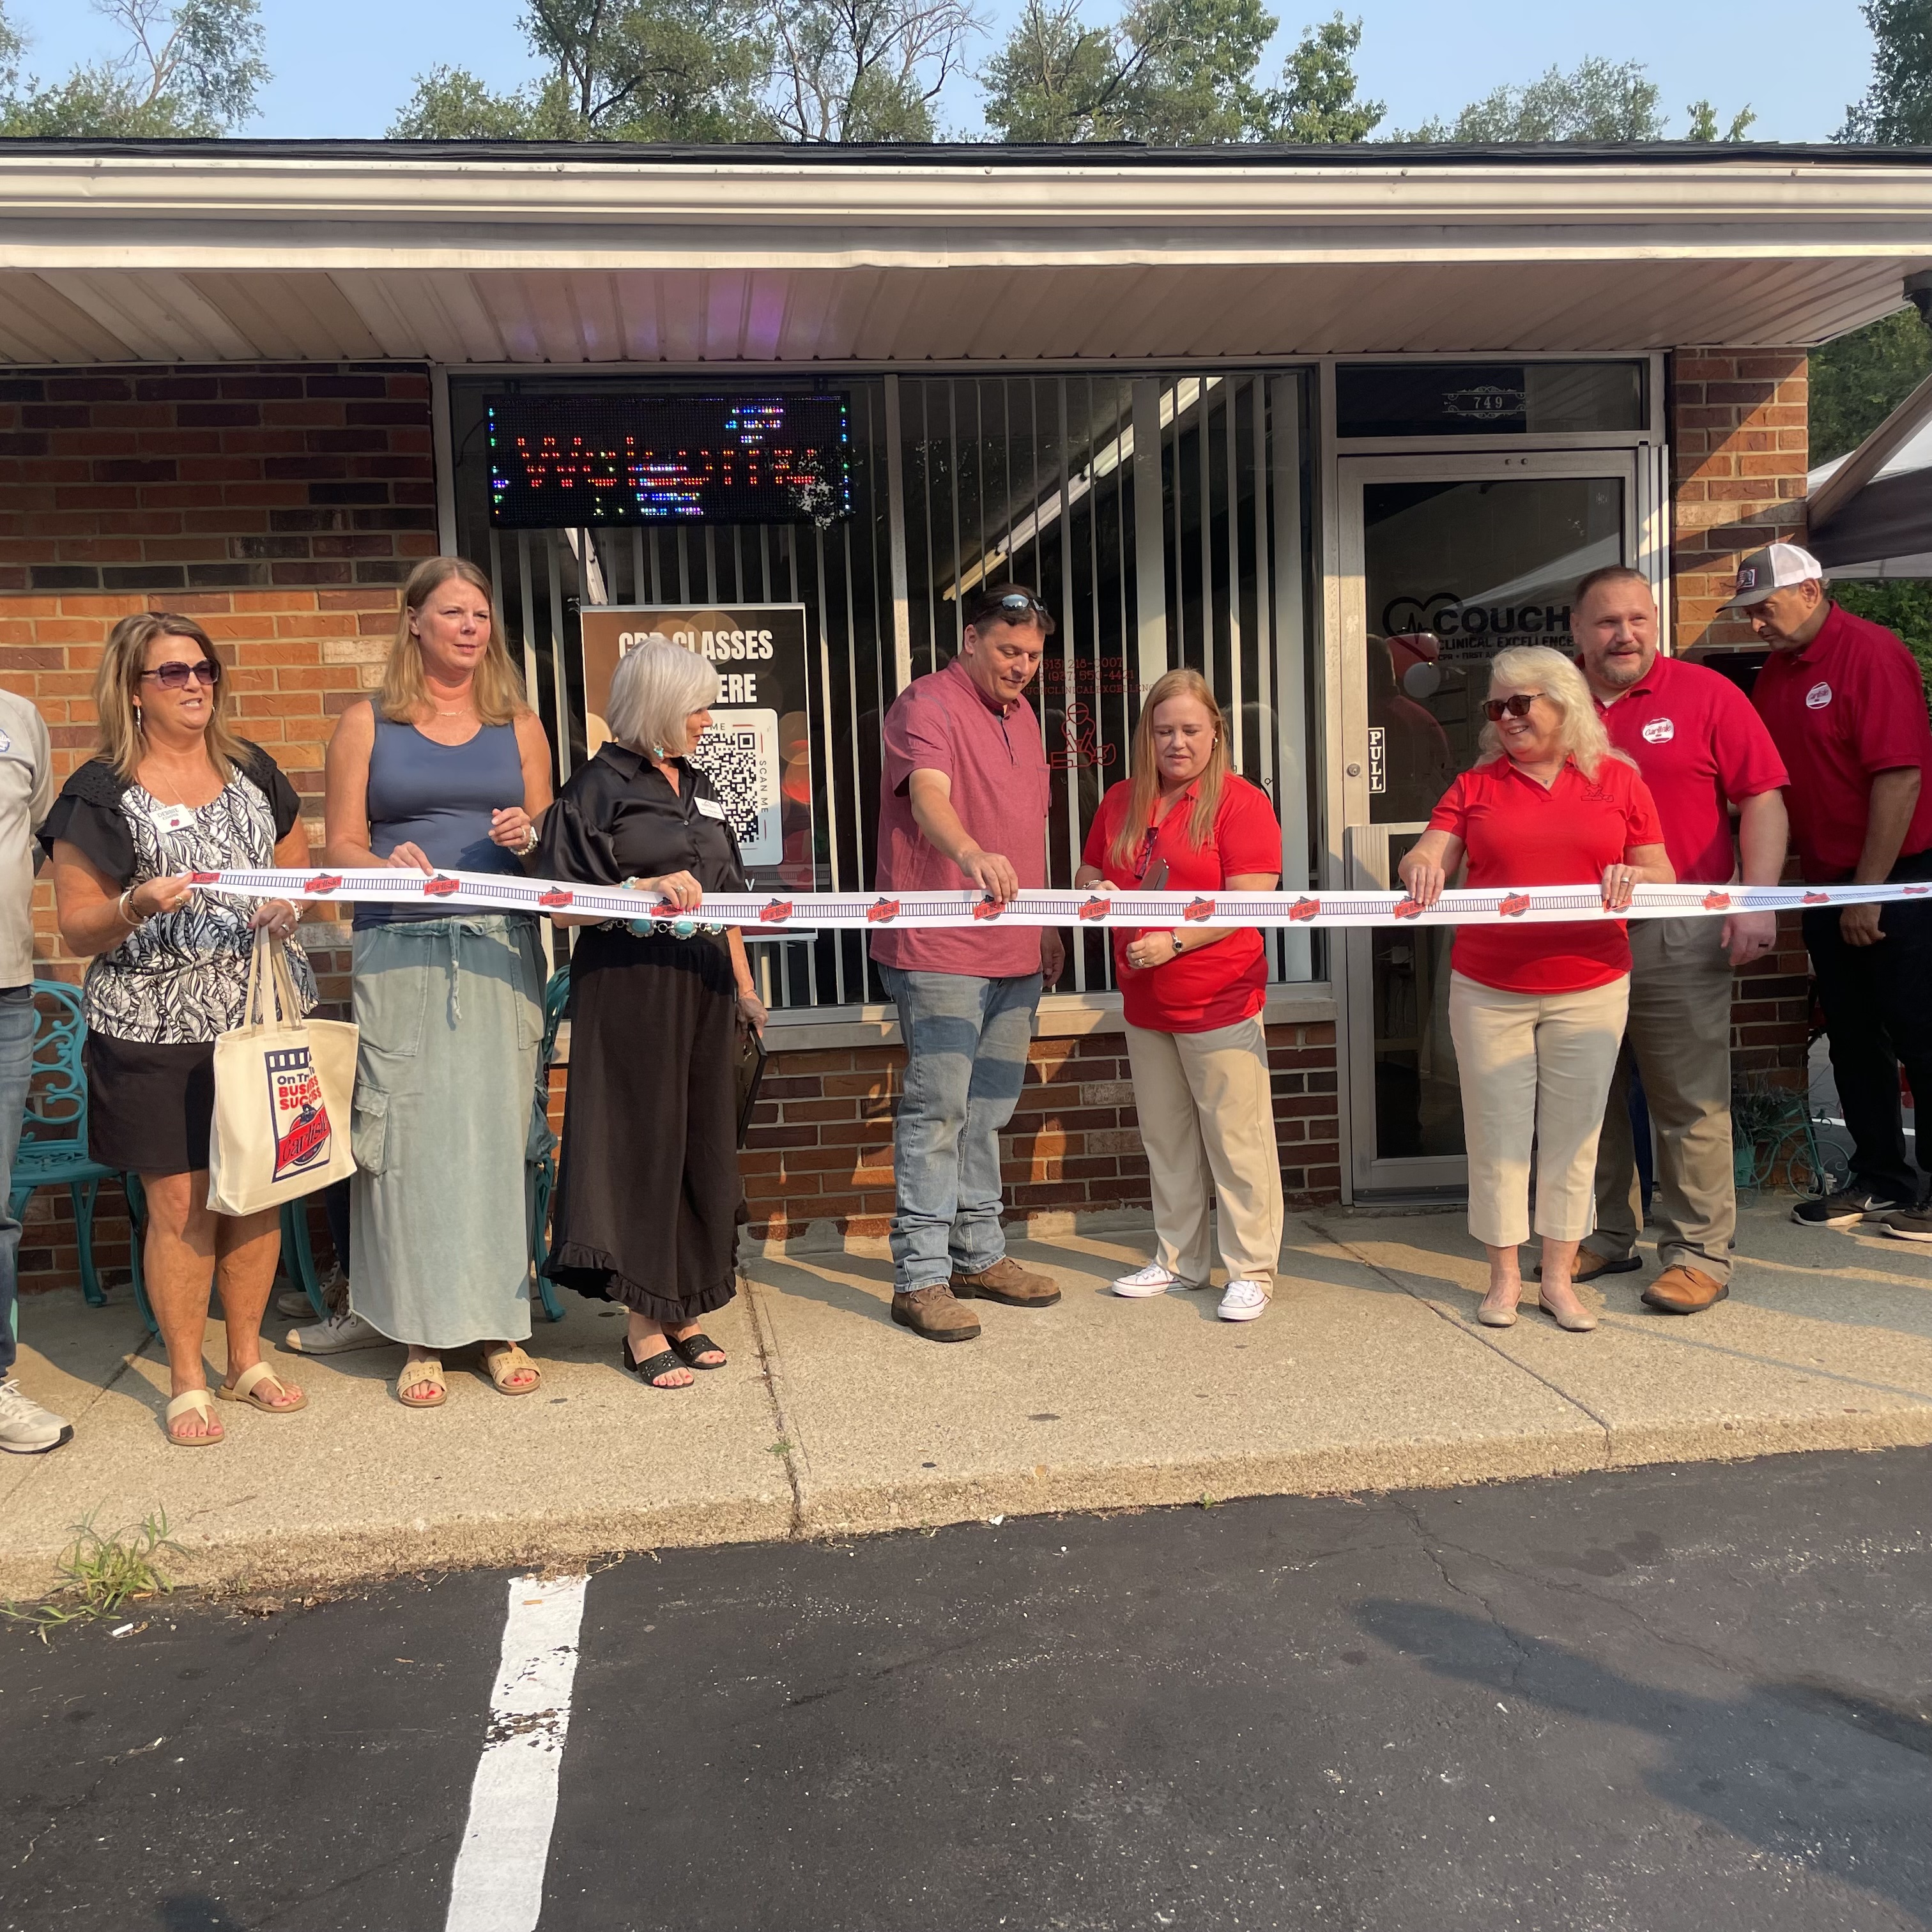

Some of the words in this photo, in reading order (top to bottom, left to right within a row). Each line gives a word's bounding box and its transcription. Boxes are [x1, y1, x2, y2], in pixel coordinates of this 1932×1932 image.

[1473, 396, 1503, 409] 749
[1432, 606, 1570, 635] COUCH
[1439, 637, 1492, 650] CLINICAL
[712, 673, 758, 703] ERE
[1370, 731, 1382, 790] PULL
[759, 760, 768, 792] SCAN
[760, 797, 769, 813] ME
[307, 877, 340, 891] Carlisle
[427, 880, 458, 893] Carlisle
[540, 893, 572, 905] Carlisle
[762, 902, 791, 919] Carlisle
[870, 901, 898, 919] Carlisle
[1082, 901, 1109, 917] Carlisle
[1186, 901, 1214, 918] Carlisle
[1291, 901, 1319, 918] Carlisle
[277, 1075, 295, 1085] On
